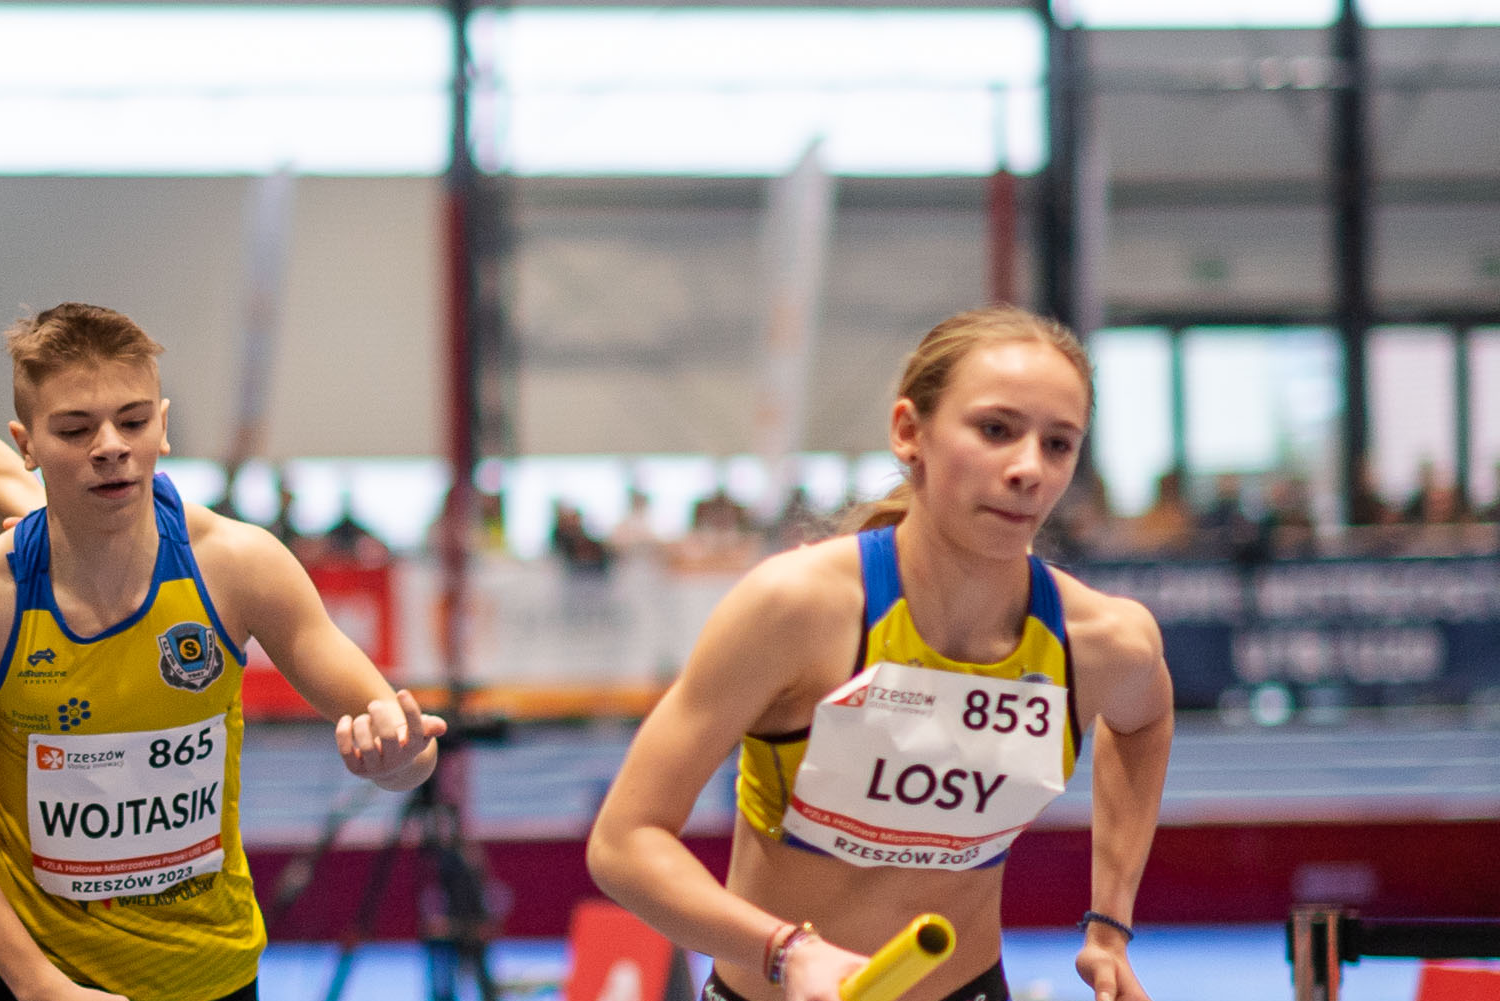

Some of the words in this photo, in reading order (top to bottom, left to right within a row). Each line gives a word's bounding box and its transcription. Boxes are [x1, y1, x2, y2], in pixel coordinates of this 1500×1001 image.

[184, 641, 198, 657] S
[962, 689, 1050, 738] 853
[67, 750, 125, 763] rzeszów
[148, 726, 214, 769] 865
[866, 757, 1008, 814] LOSY
[38, 781, 219, 839] WOJTASIK
[834, 835, 936, 865] RZESZÓW
[72, 874, 154, 893] RZESZÓW
[157, 865, 193, 885] 2023
